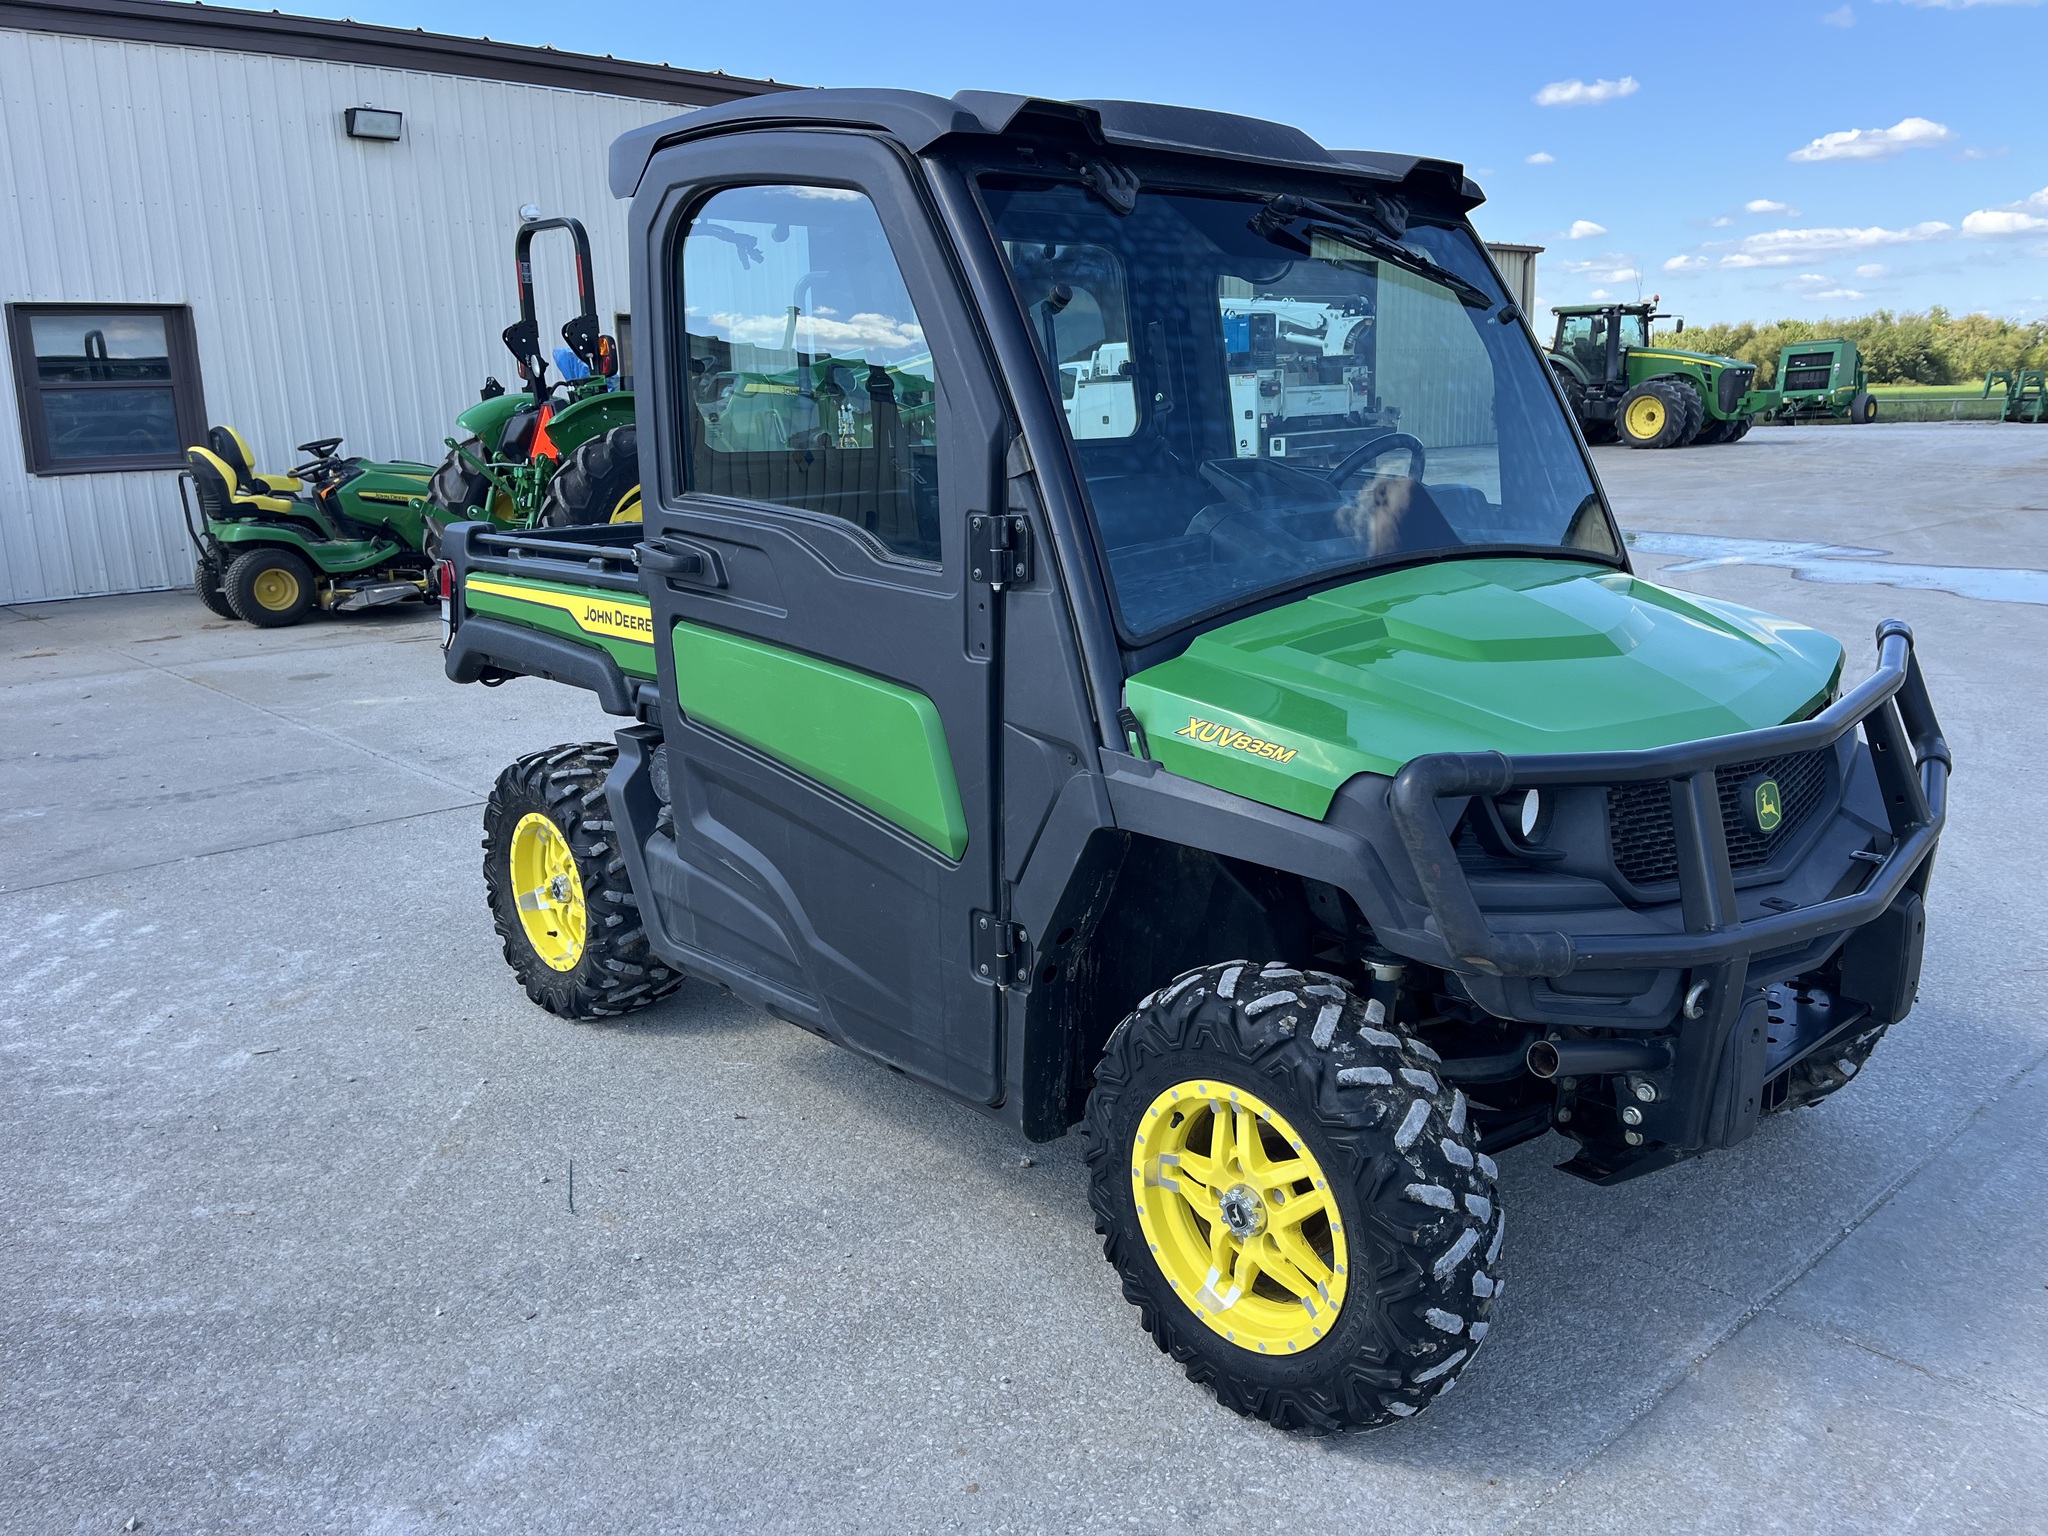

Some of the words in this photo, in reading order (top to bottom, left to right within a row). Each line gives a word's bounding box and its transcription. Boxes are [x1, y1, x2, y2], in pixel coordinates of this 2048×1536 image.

[584, 605, 612, 625] JOHN
[615, 610, 652, 632] DEERE
[1174, 716, 1298, 762] XUV835M
